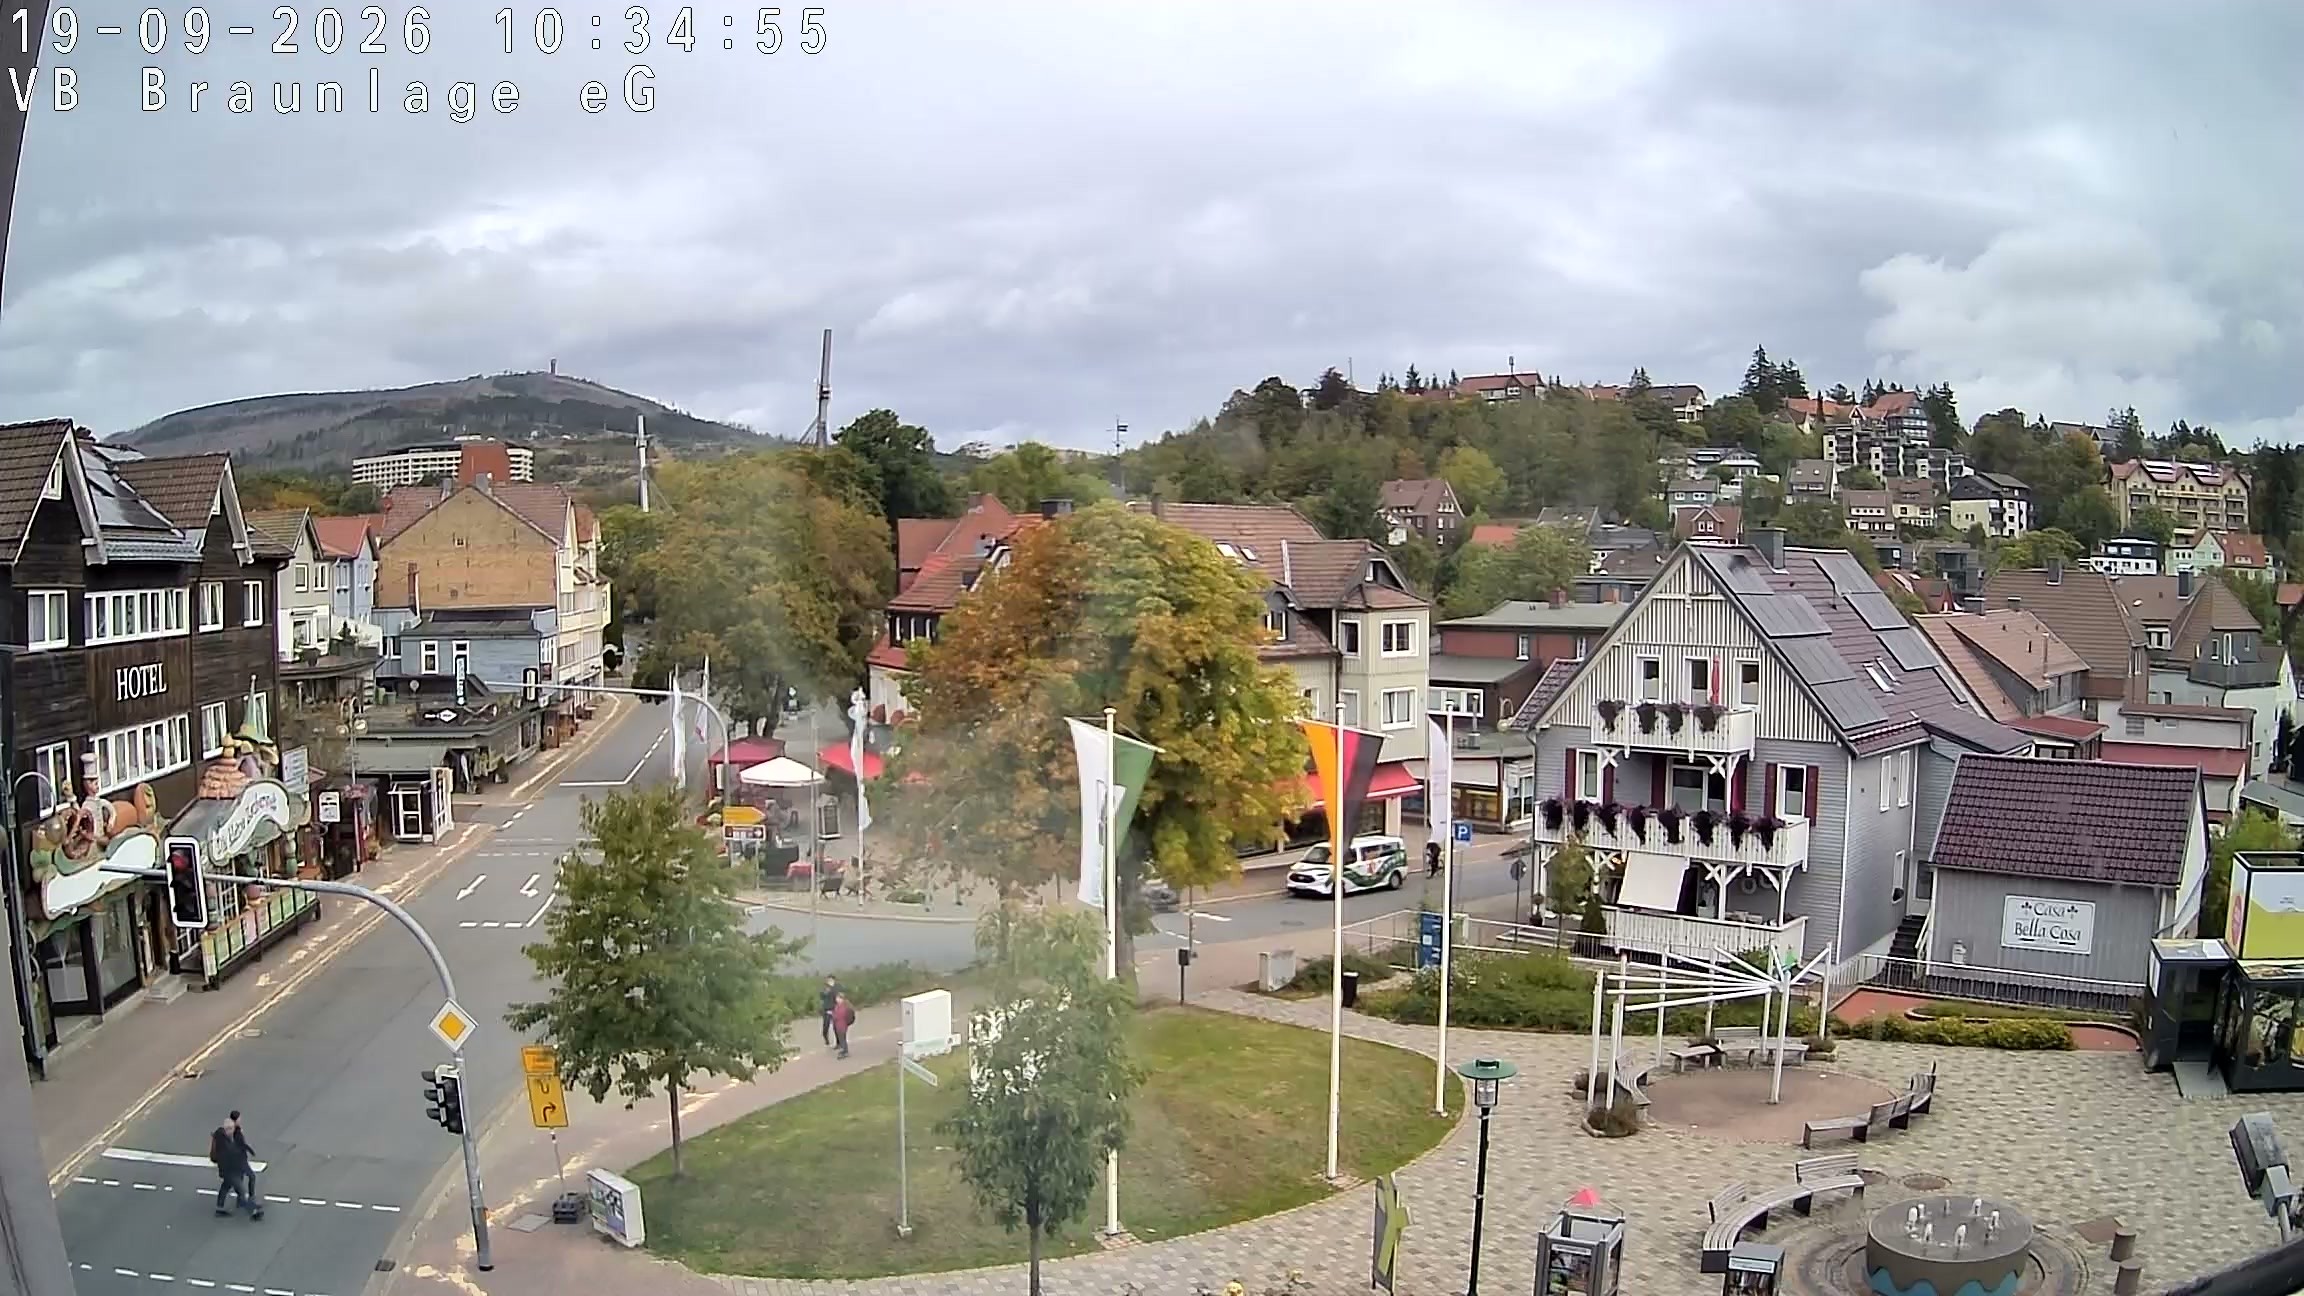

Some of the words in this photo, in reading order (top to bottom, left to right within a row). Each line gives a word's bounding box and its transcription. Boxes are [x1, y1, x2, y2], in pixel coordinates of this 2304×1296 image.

[116, 663, 167, 701] HOTEL
[2034, 902, 2065, 917] Casa
[2014, 917, 2046, 938] Bella
